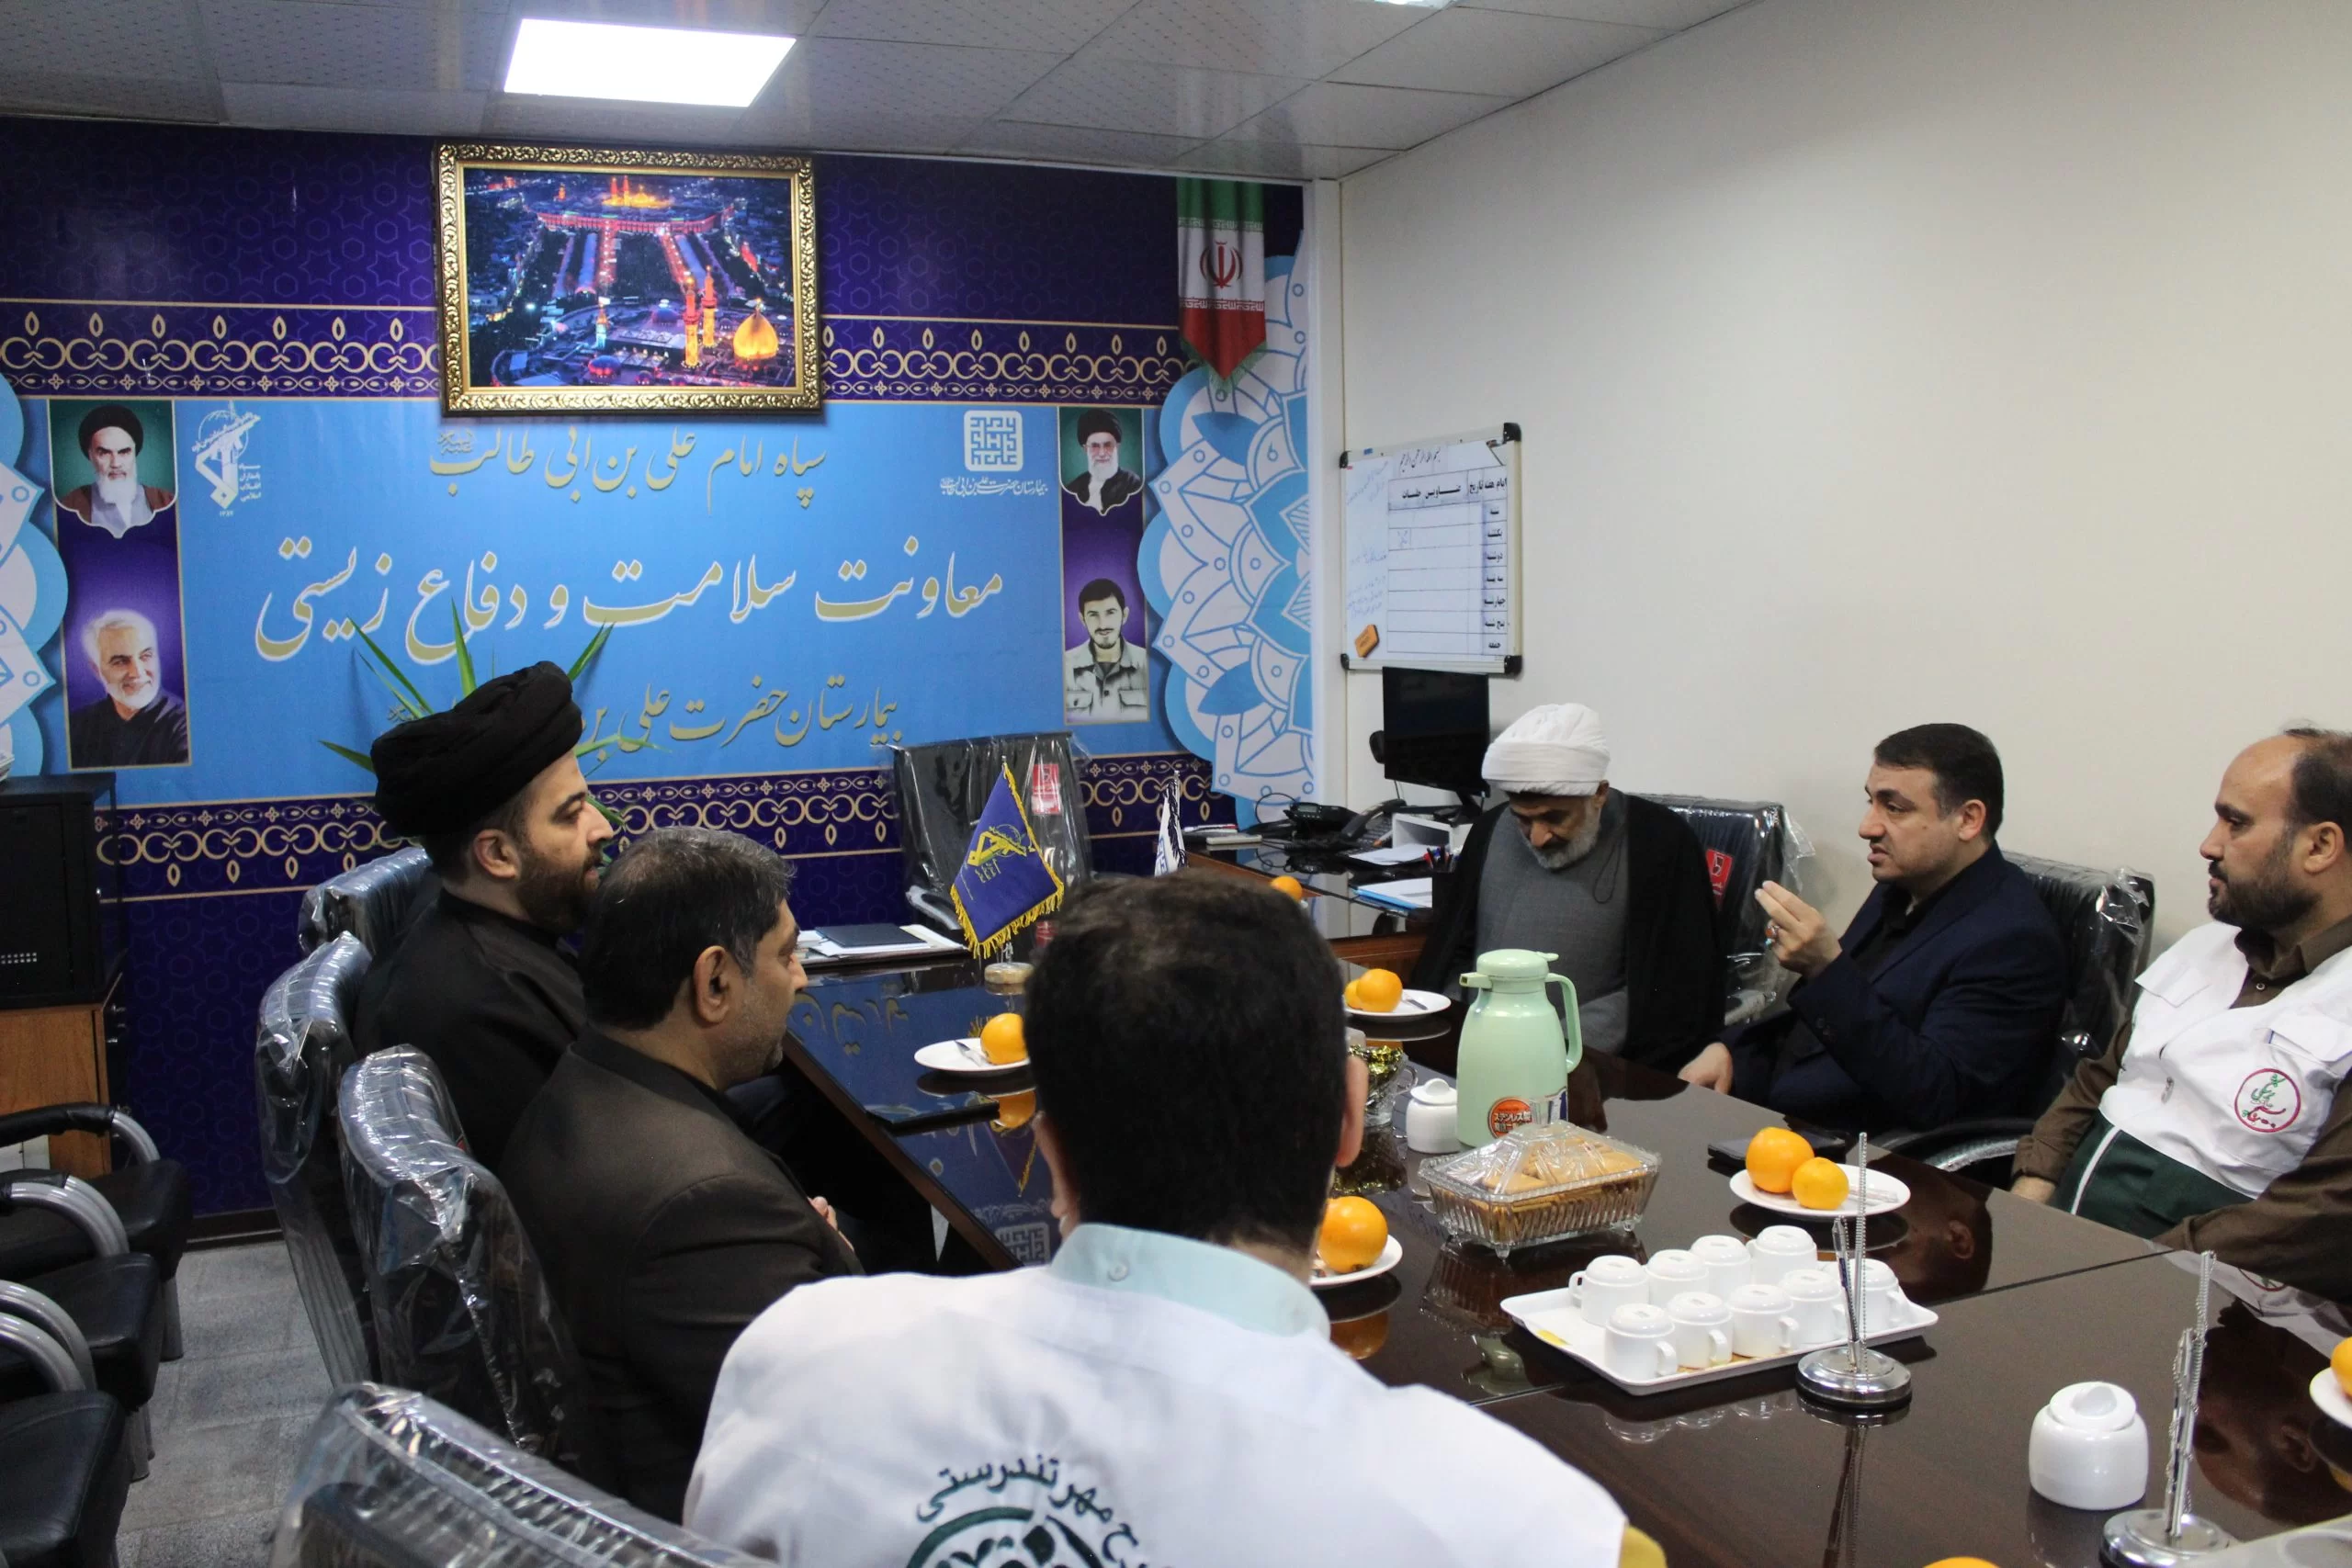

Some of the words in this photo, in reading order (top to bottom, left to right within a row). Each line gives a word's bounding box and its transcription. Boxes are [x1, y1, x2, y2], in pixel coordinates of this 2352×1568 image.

[429, 427, 536, 497] طالب
[545, 425, 592, 503] ابی
[592, 445, 638, 499] بن
[645, 425, 695, 491] علی
[707, 434, 763, 515] امام
[773, 434, 827, 509] سپاه
[254, 536, 393, 662] زیستی
[405, 550, 527, 665] دفاع
[543, 583, 569, 629] و
[582, 554, 797, 627] سلامت
[815, 536, 1003, 622] معاونت
[617, 682, 672, 753] علی
[669, 675, 788, 749] حضرت
[775, 674, 903, 747] بیمارستان
[916, 1453, 1059, 1523] تندرستی
[1047, 1483, 1114, 1524] مهر
